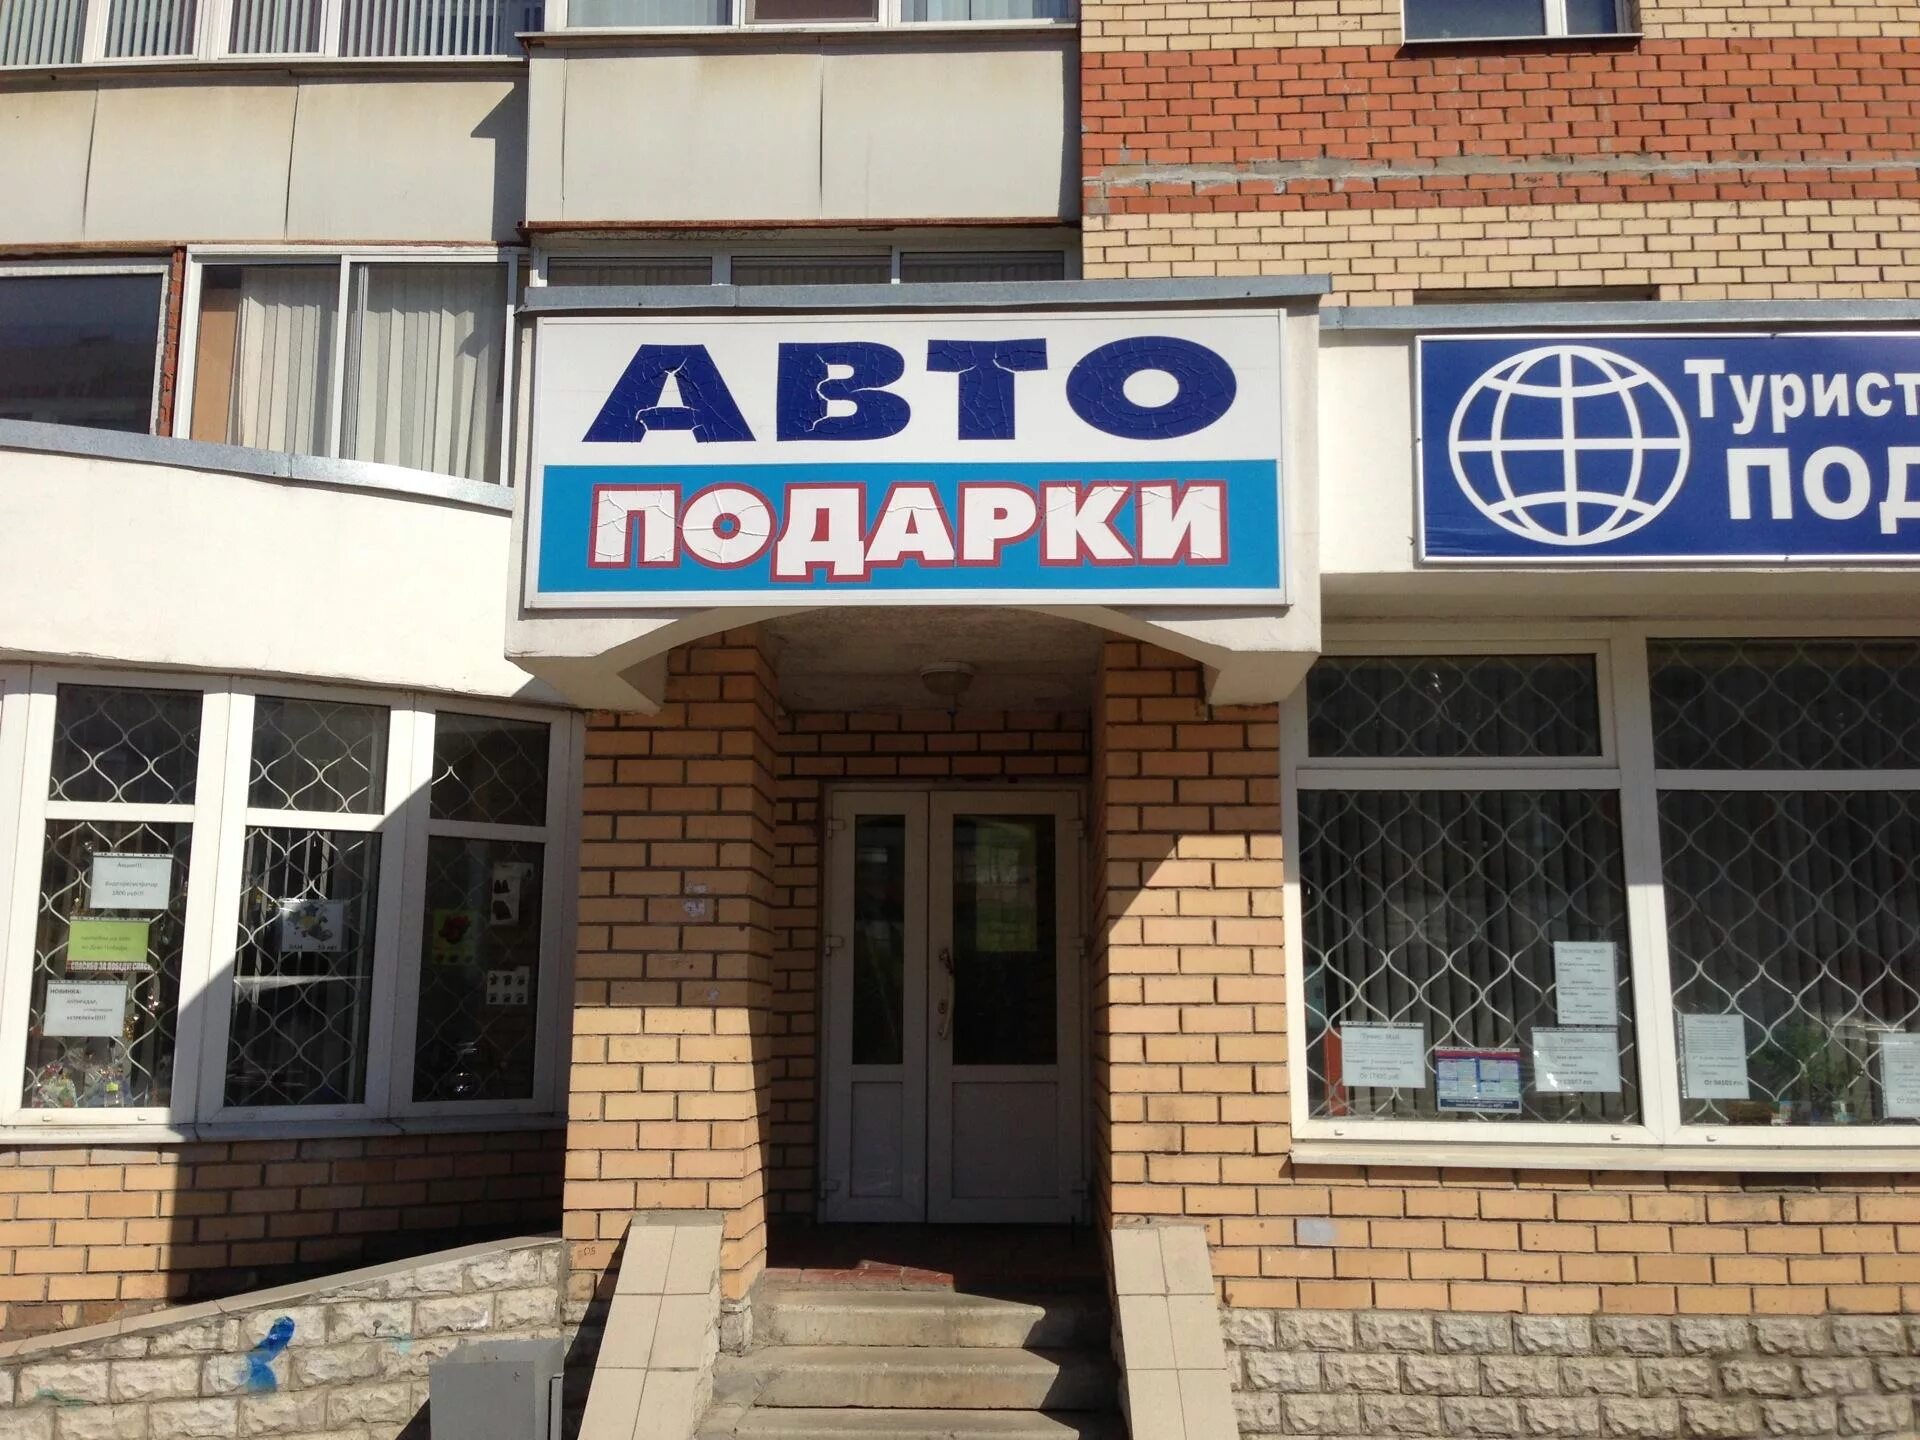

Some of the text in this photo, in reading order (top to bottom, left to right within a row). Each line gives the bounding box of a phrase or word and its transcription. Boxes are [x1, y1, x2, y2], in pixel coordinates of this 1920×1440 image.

[582, 336, 1237, 443] АВТО
[1684, 359, 1920, 435] Турист
[588, 479, 1229, 583] ПОДАРКИ
